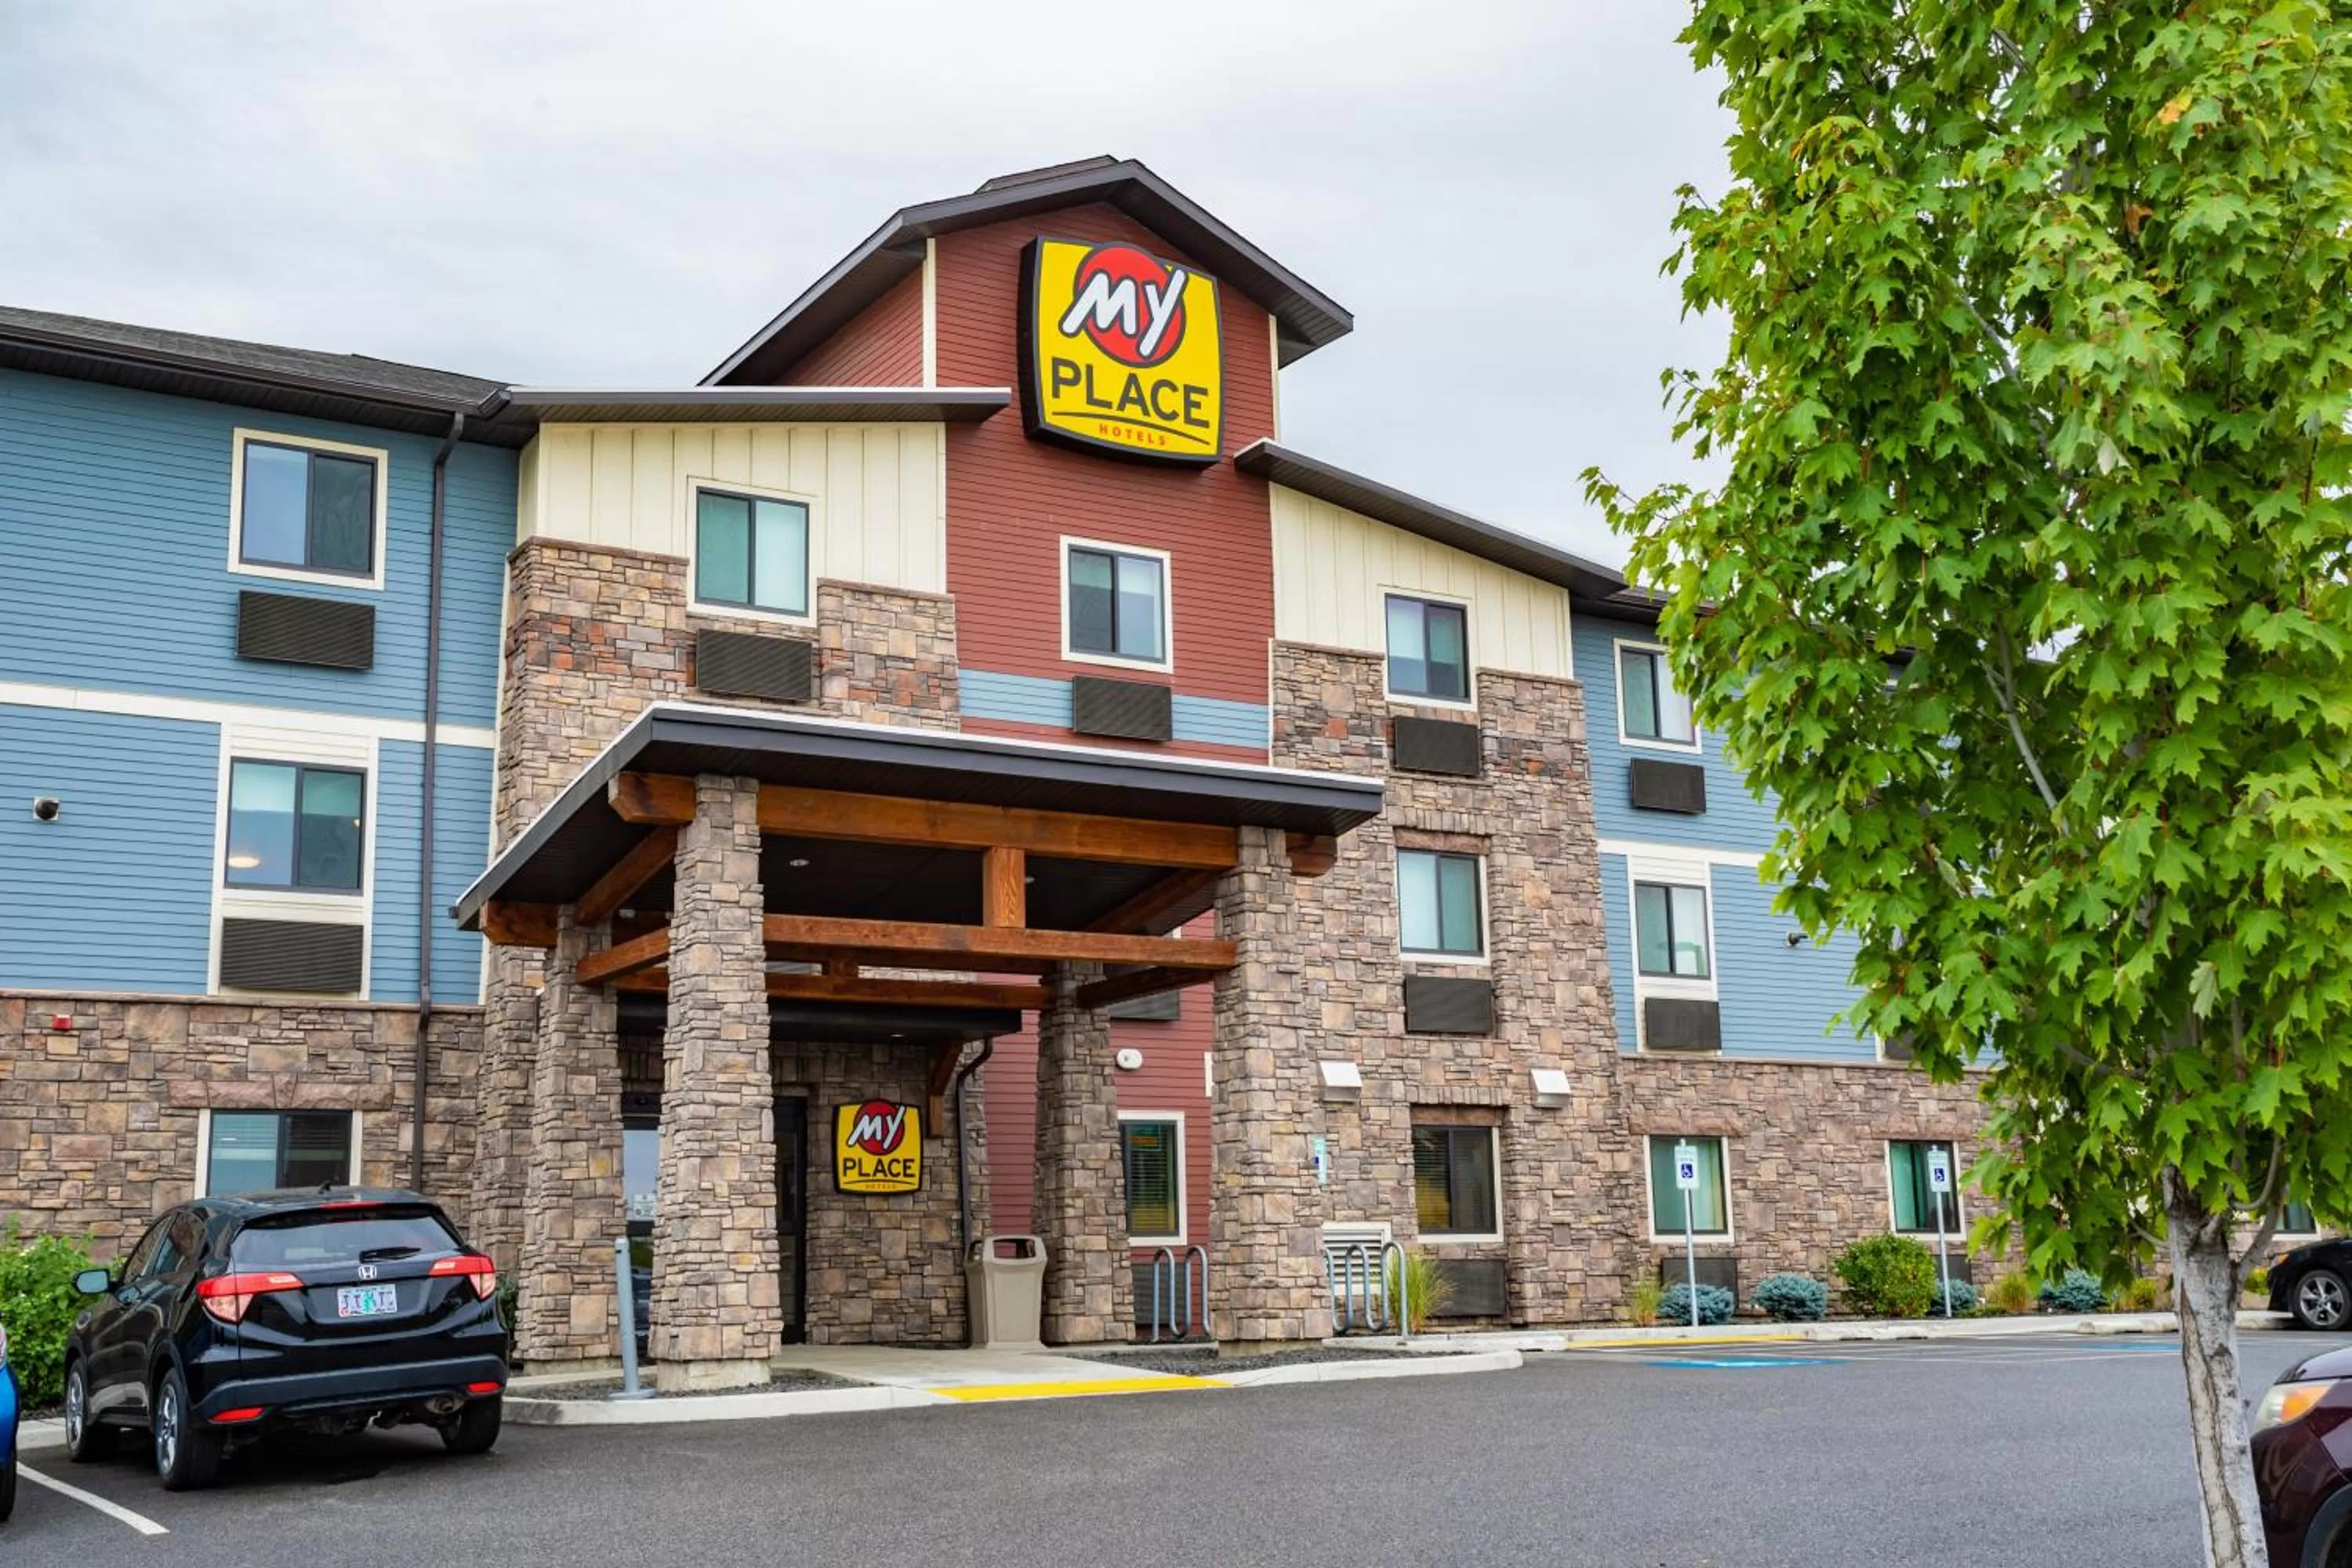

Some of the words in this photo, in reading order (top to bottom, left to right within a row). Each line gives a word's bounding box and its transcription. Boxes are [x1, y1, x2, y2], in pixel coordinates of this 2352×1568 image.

[1051, 356, 1210, 428] PLACE
[1098, 423, 1167, 446] HOTELS
[843, 1157, 916, 1178] PLACE
